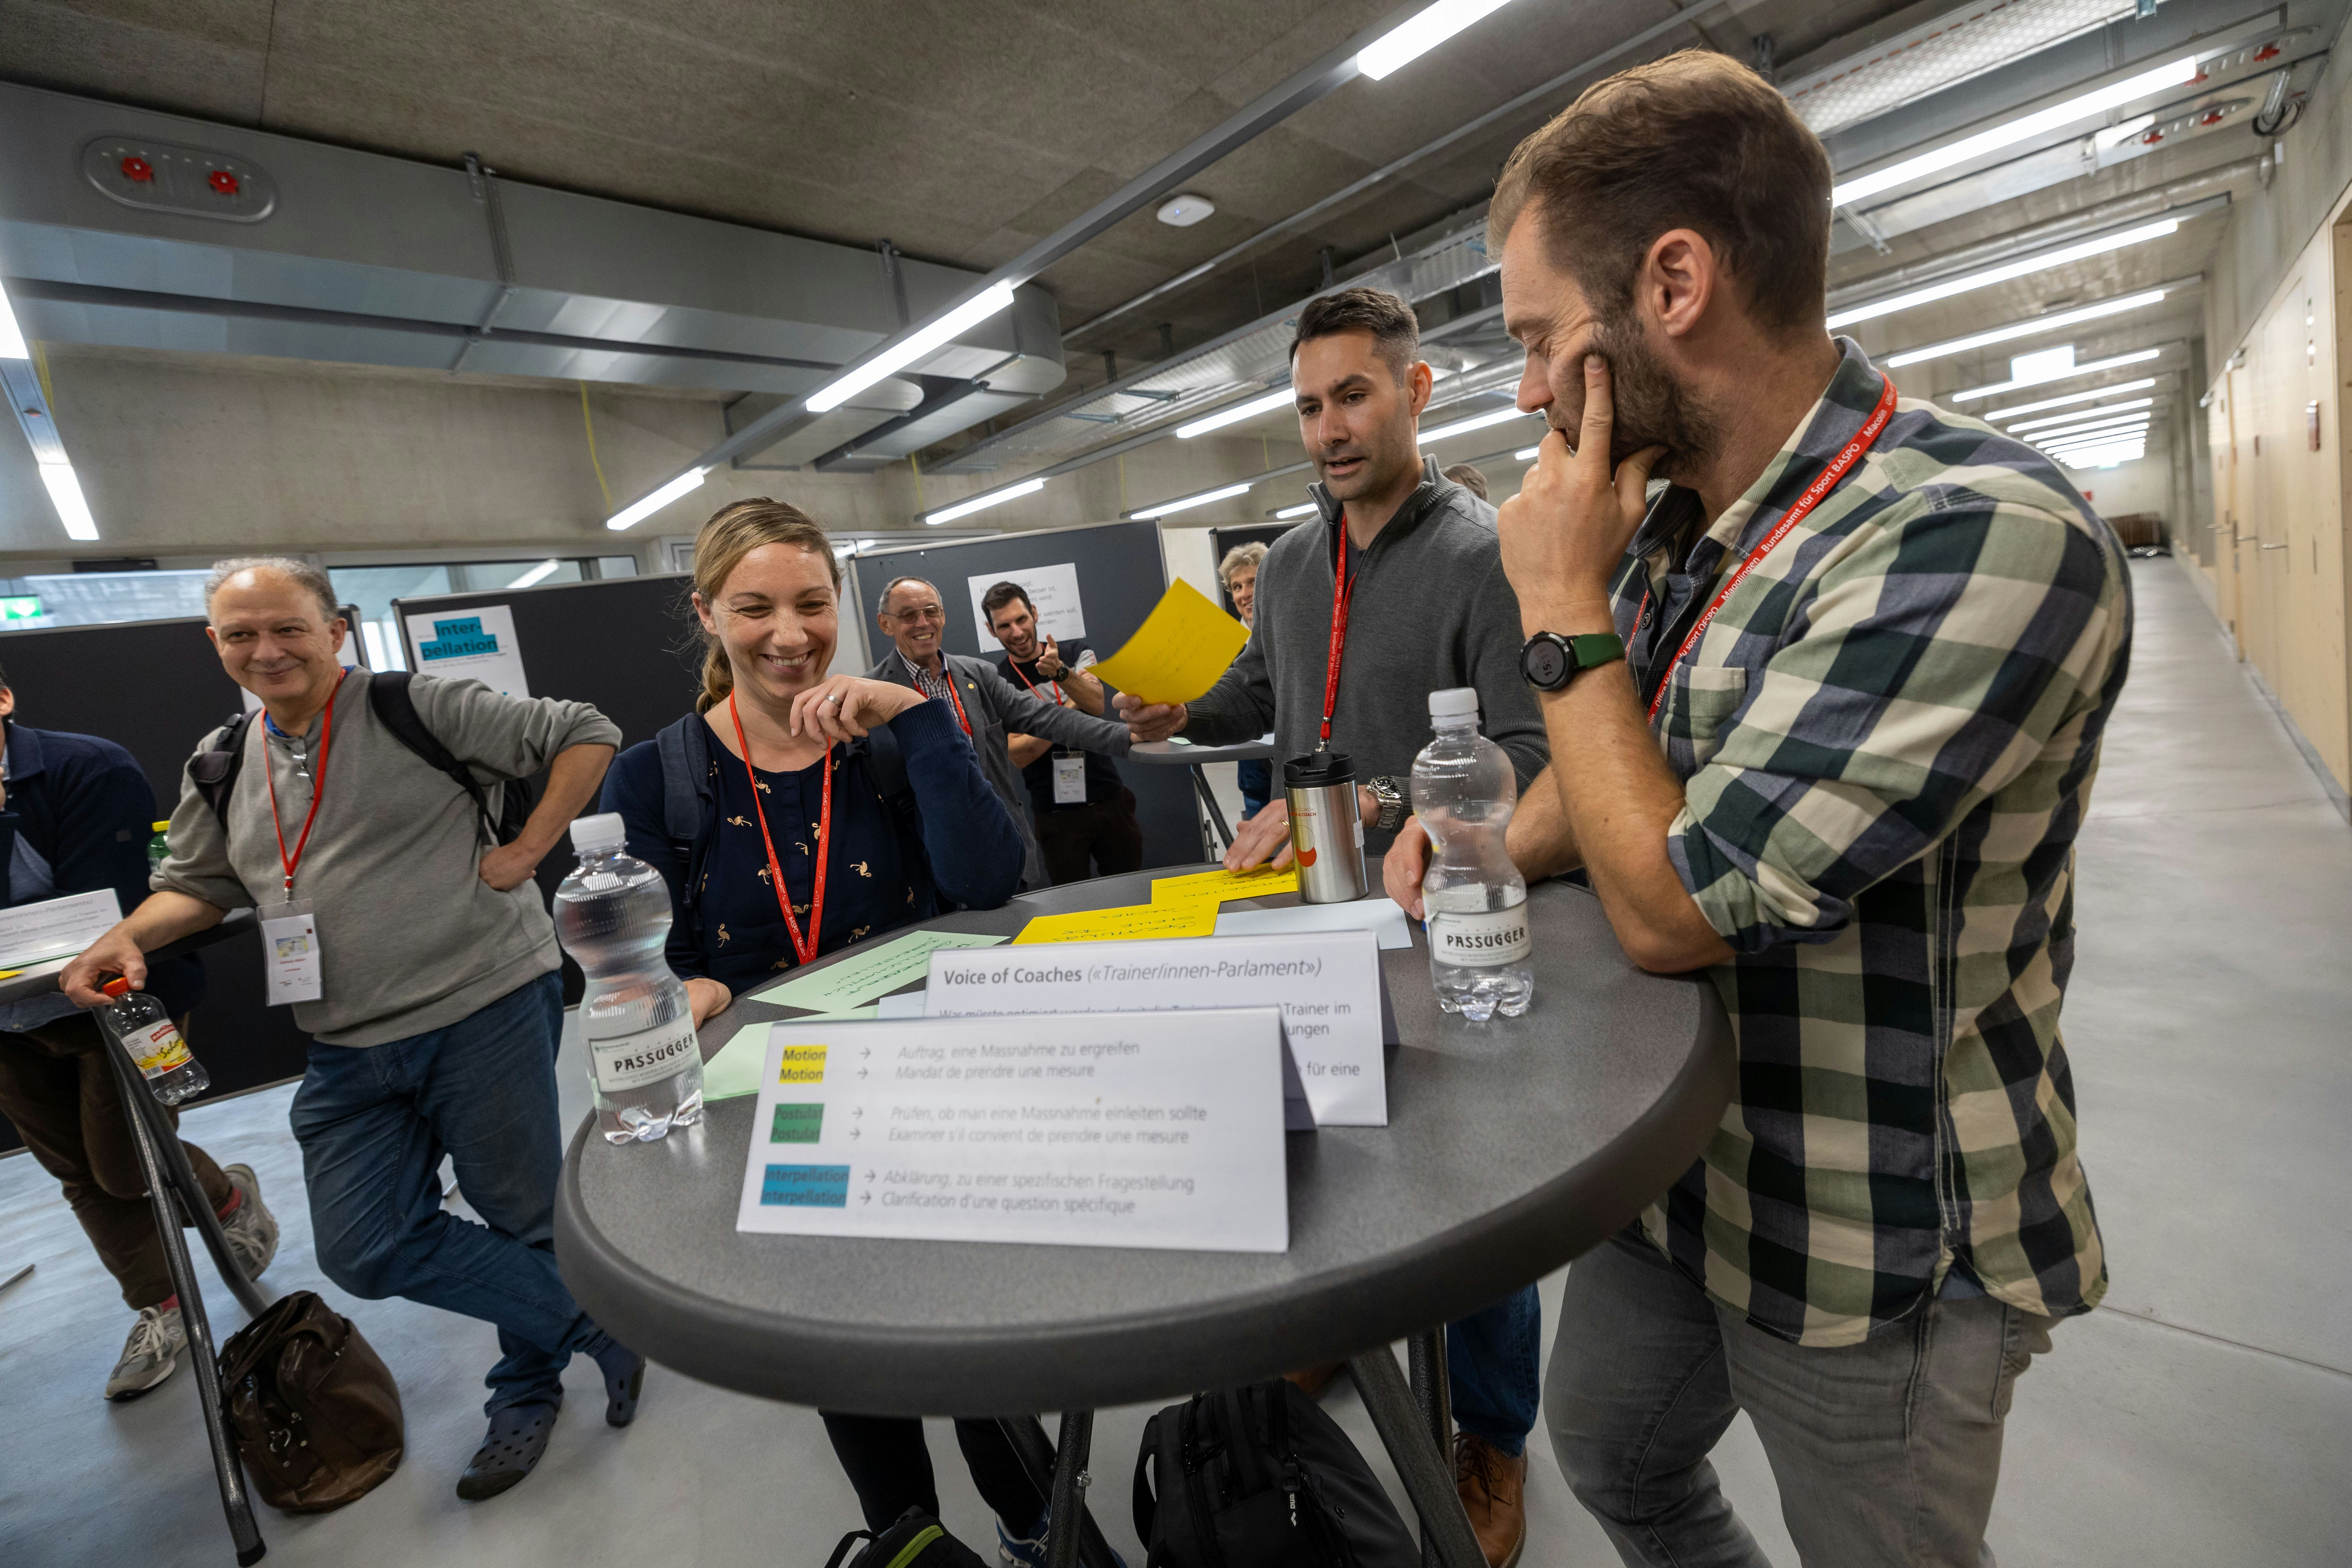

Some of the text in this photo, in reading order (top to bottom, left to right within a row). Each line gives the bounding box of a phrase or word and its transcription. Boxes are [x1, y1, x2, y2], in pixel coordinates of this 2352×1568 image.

[1761, 508, 1803, 553] Bundesamt
[1799, 494, 1814, 508] für
[1811, 471, 1835, 495] Sport
[1832, 443, 1860, 472] BASPO
[1864, 410, 1887, 437] Macolin
[435, 623, 481, 636] Inter-
[1686, 631, 1701, 650] sport
[1698, 606, 1719, 630] OFSPO
[422, 640, 497, 661] pellation
[1446, 927, 1525, 949] PASSUGGER
[944, 957, 1322, 985] Voice of Coaches («Trainer/innen-Parlament»)
[1284, 1003, 1330, 1016] Trainer
[1334, 1002, 1351, 1015] im
[1286, 1024, 1330, 1039] ungen
[614, 1033, 693, 1072] PASSUGGER
[783, 1049, 826, 1062] Motion
[898, 1040, 1140, 1062] Auftrag, eine Massnahme zu ergreifen
[779, 1069, 824, 1081] Motion
[895, 1065, 1095, 1081] Mandat de prendre une mesure
[1307, 1062, 1361, 1076] für eine
[775, 1106, 824, 1121] Postulat
[890, 1105, 1207, 1122] Prüfen, ob man eine Massnahme einleiten sollte
[771, 1127, 820, 1140] Postulat
[888, 1127, 945, 1142] Examiner
[969, 1128, 1022, 1143] convient
[1027, 1127, 1044, 1143] de
[1047, 1128, 1101, 1145] prendre
[1105, 1131, 1132, 1143] une
[1136, 1131, 1189, 1144] mesure
[764, 1167, 849, 1185] Interpellation
[956, 1174, 972, 1187] zu
[976, 1173, 1008, 1187] einer
[1012, 1172, 1094, 1190] spezifischen
[1098, 1172, 1195, 1195] Fragestellung
[762, 1190, 846, 1207] Interpellation
[881, 1190, 956, 1208] Clarification
[1001, 1196, 1059, 1213] question
[1064, 1197, 1136, 1216] spécifique
